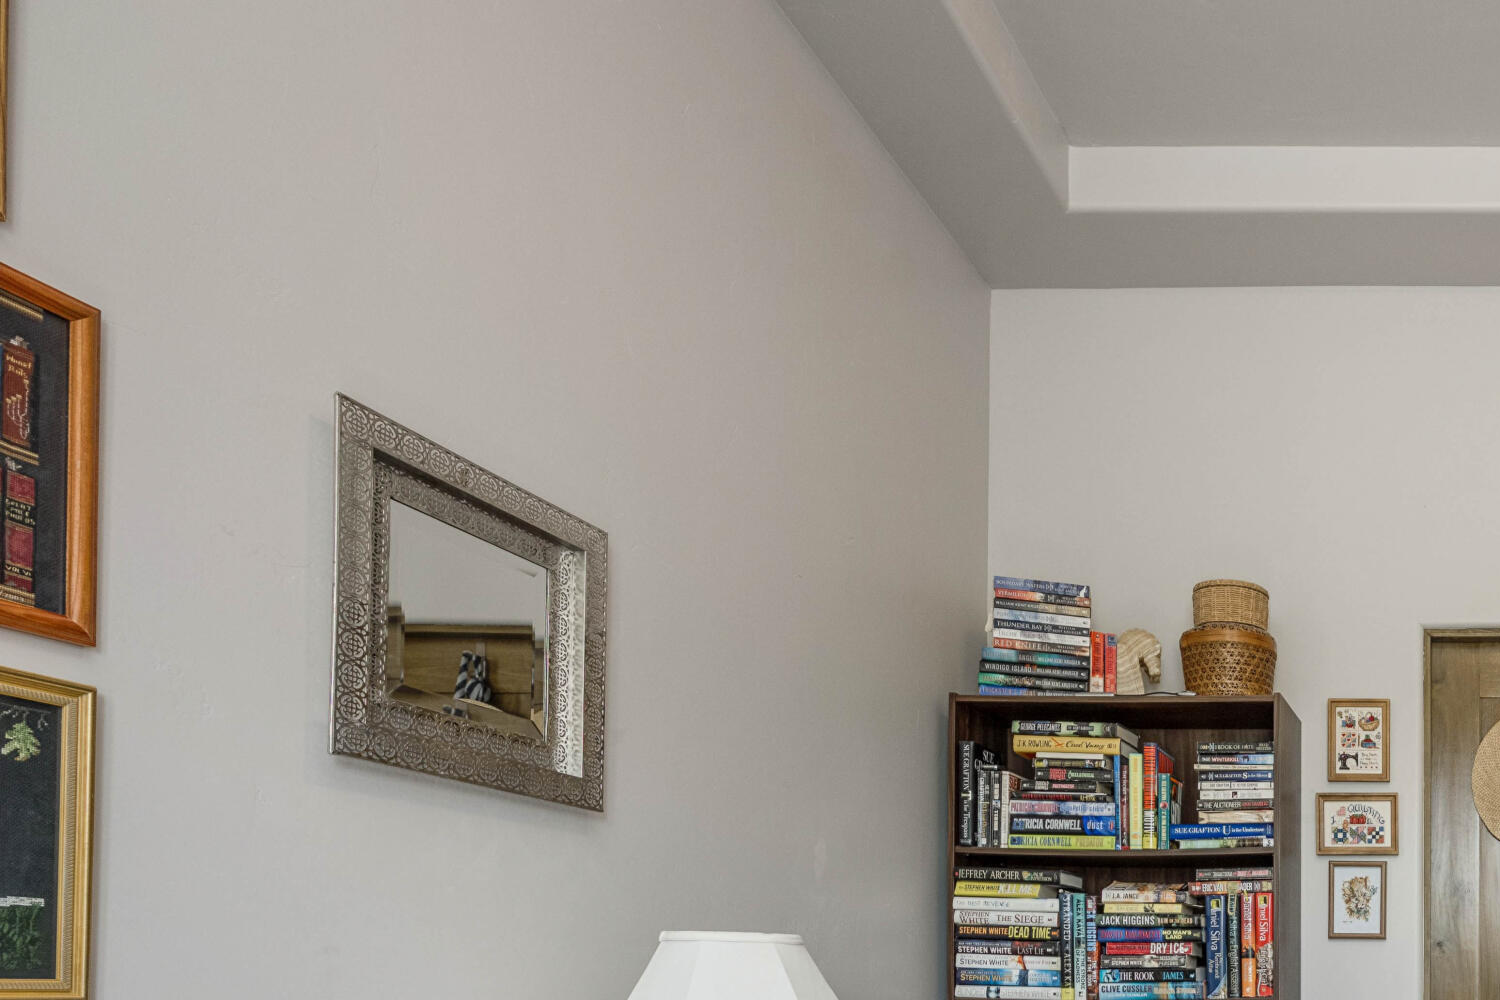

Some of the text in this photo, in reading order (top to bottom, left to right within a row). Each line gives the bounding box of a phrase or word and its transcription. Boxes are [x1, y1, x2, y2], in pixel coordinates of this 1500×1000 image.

[958, 868, 1019, 880] JEFFREY ARCHER
[1100, 915, 1155, 926] JACK HIGGINS
[959, 926, 1051, 939] STEPHEN WHITE DEAD TIME
